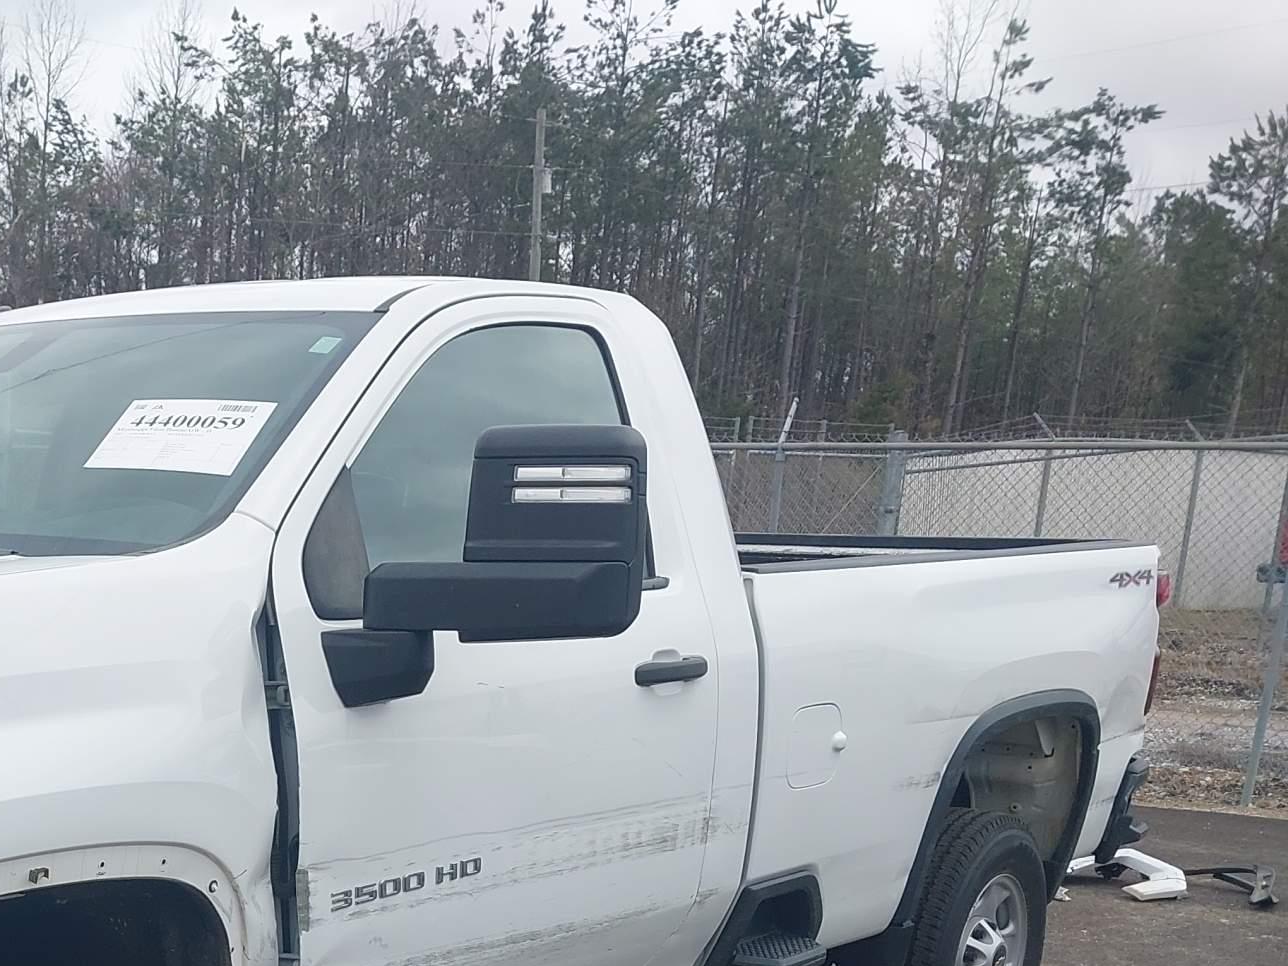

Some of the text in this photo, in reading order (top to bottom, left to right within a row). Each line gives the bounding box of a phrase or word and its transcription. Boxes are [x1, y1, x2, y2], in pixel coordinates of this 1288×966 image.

[130, 414, 247, 430] 44400059
[330, 857, 482, 913] 3500 HD
